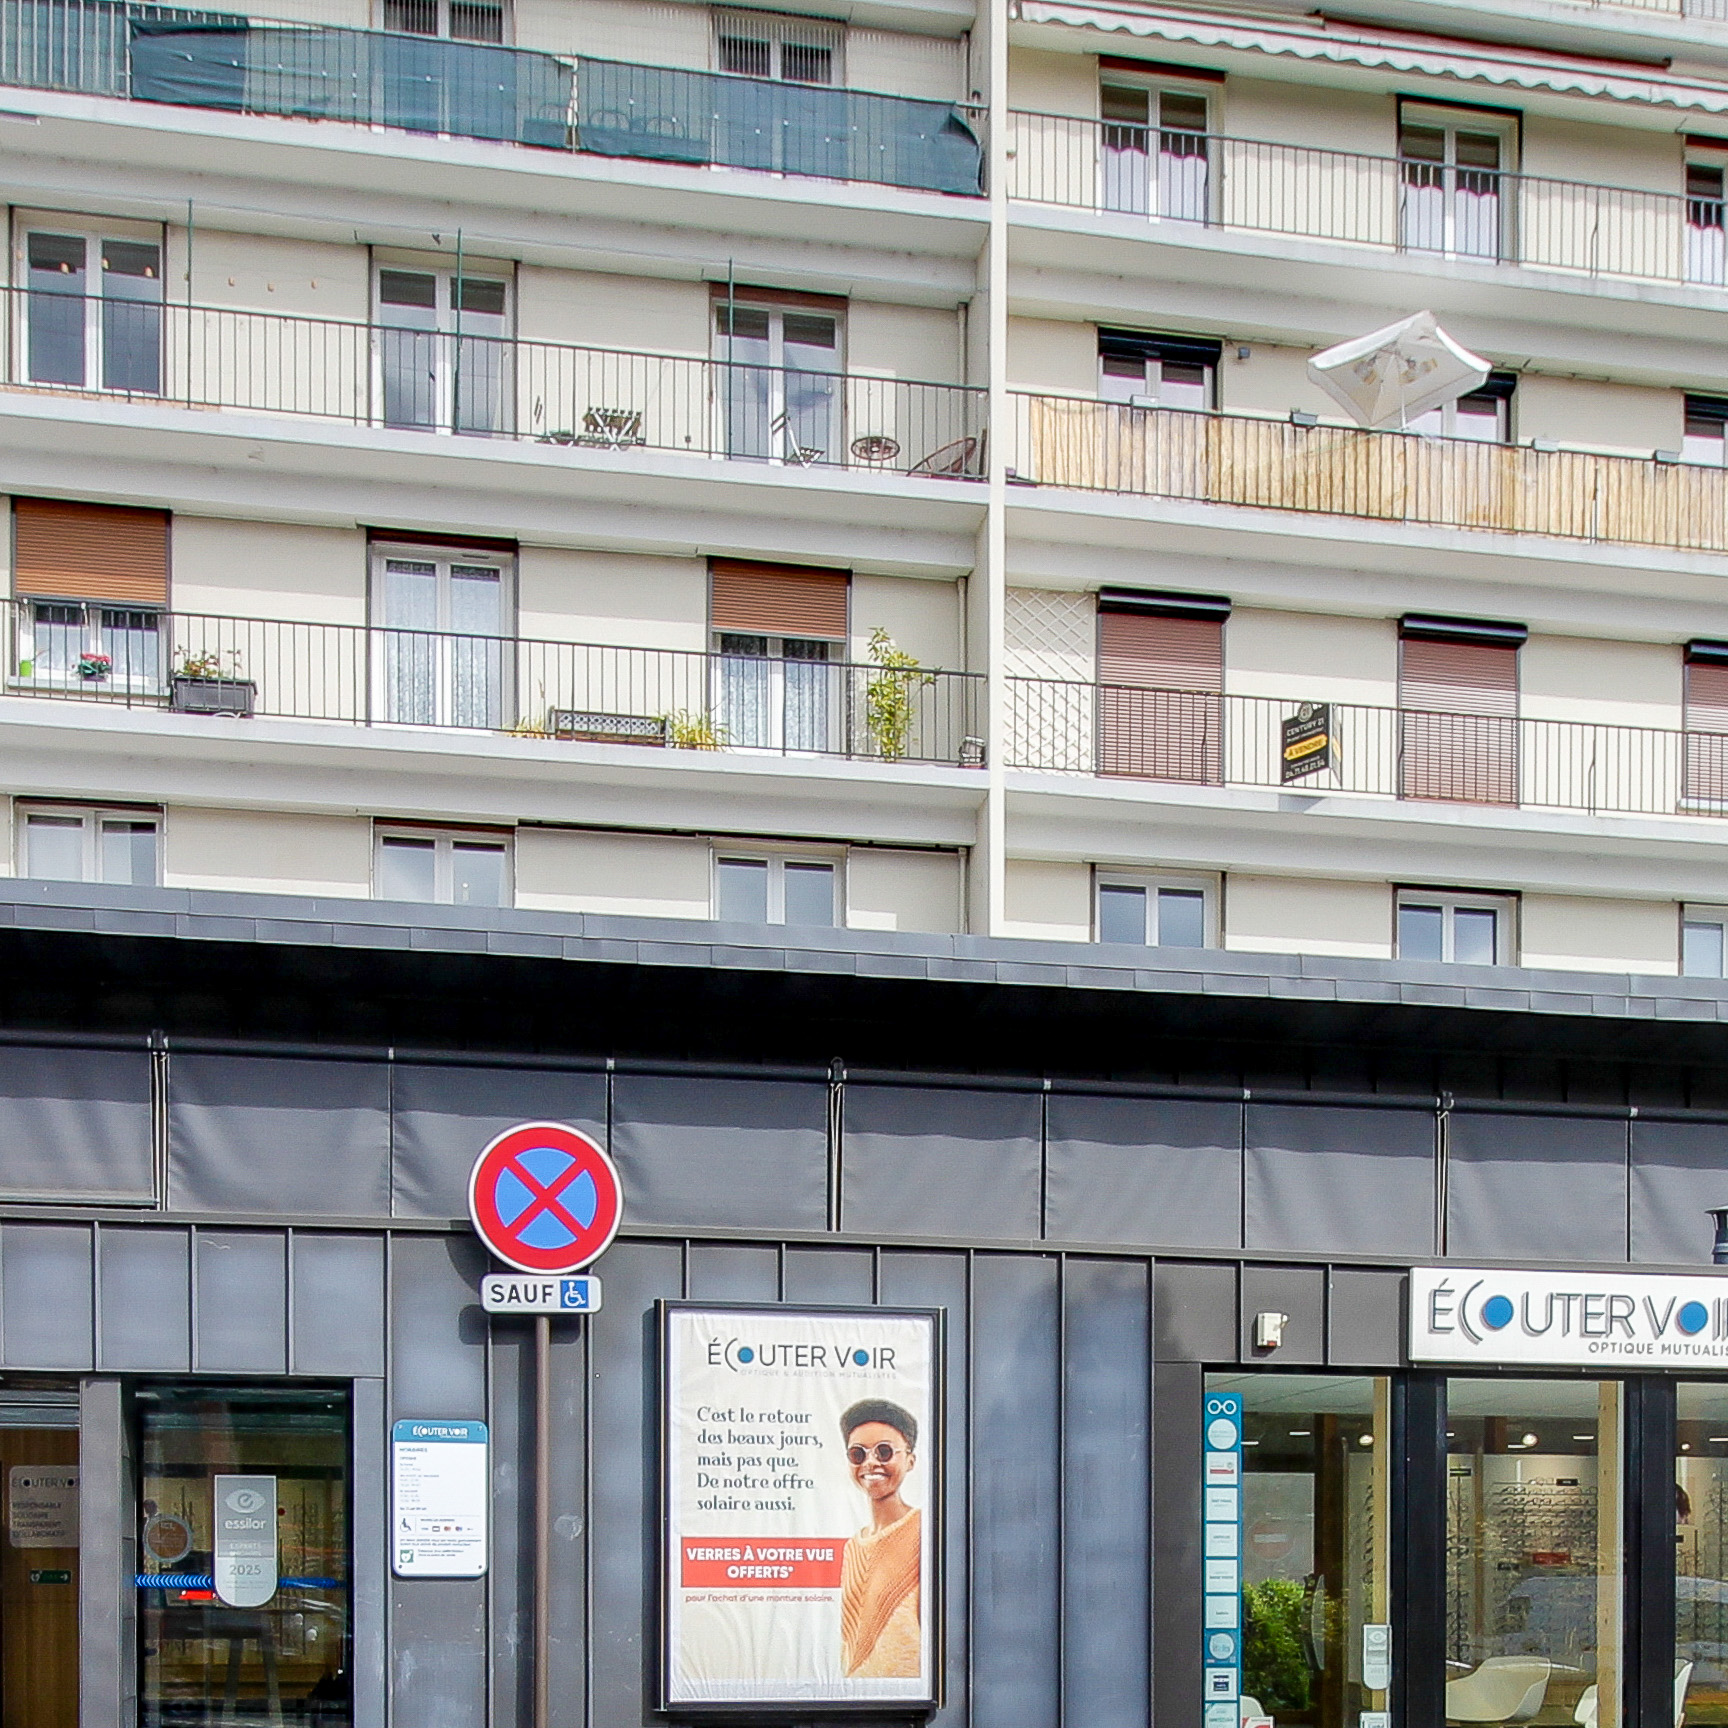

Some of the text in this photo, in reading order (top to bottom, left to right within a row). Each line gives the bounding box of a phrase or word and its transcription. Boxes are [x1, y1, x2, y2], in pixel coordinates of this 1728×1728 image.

[490, 1283, 554, 1303] SAUF
[1588, 1341, 1654, 1355] OPTIQUE
[834, 1346, 896, 1370] VOIR
[697, 1406, 812, 1424] C'est le retour
[449, 1428, 468, 1436] VOIR
[697, 1429, 823, 1451] des beaux jours,
[697, 1451, 799, 1472] mais pas que.
[697, 1472, 814, 1489] De notre offre
[697, 1495, 795, 1511] solaire aussi.
[224, 1517, 266, 1530] essilor
[686, 1545, 834, 1561] VERRES À VOTRE VUE
[229, 1564, 262, 1576] 2025
[685, 1595, 706, 1603] pour
[707, 1593, 738, 1602] l'achat
[740, 1594, 764, 1602] d'une
